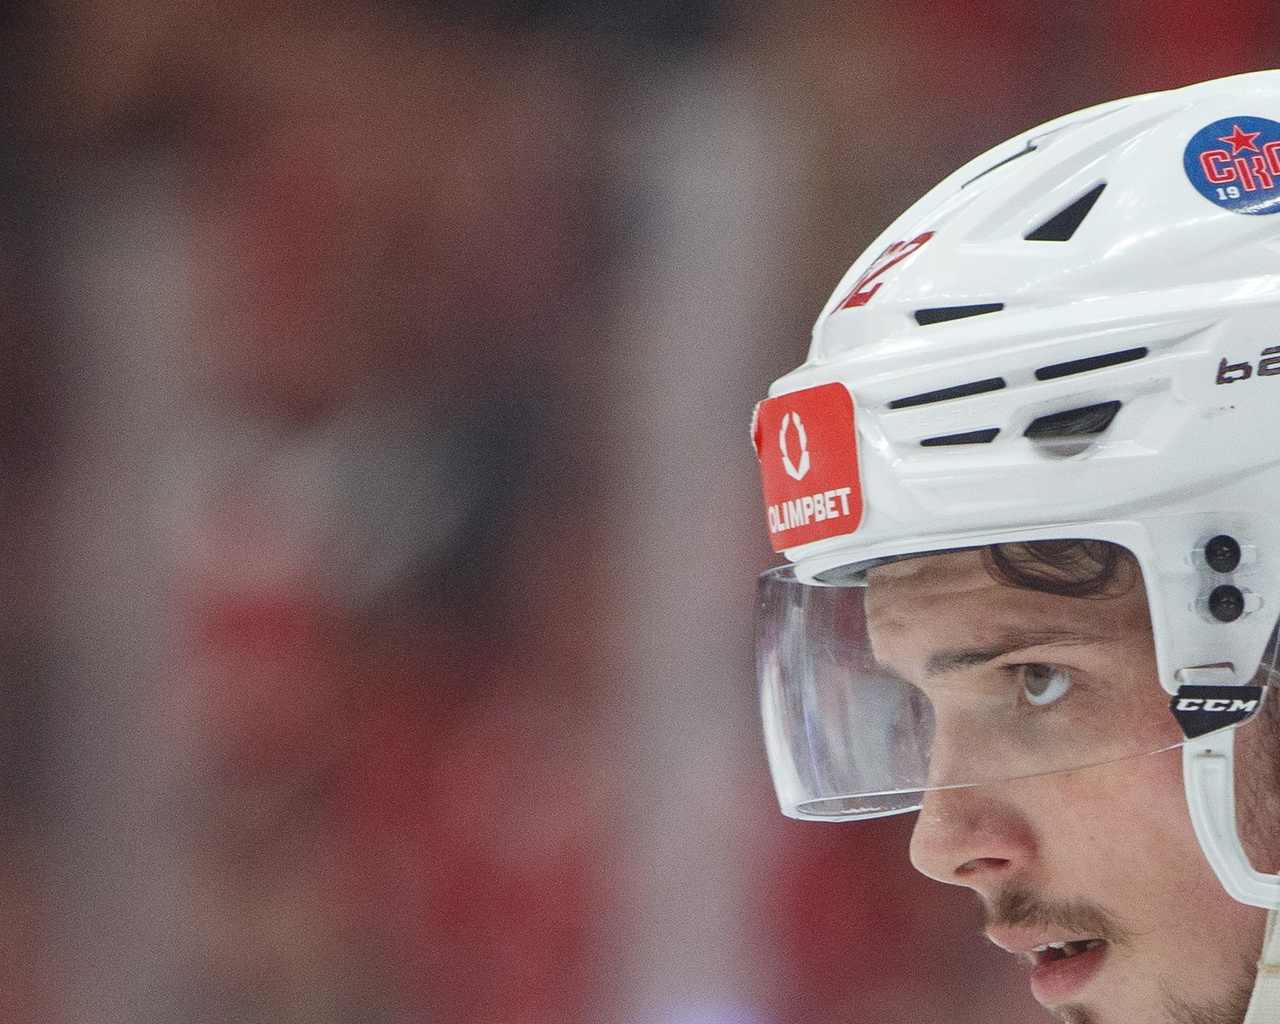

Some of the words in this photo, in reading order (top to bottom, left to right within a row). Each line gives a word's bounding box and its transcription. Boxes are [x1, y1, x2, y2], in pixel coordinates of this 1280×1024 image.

[1215, 185, 1241, 201] 19
[767, 487, 851, 534] OLIMPBET
[1176, 698, 1259, 712] CCM
